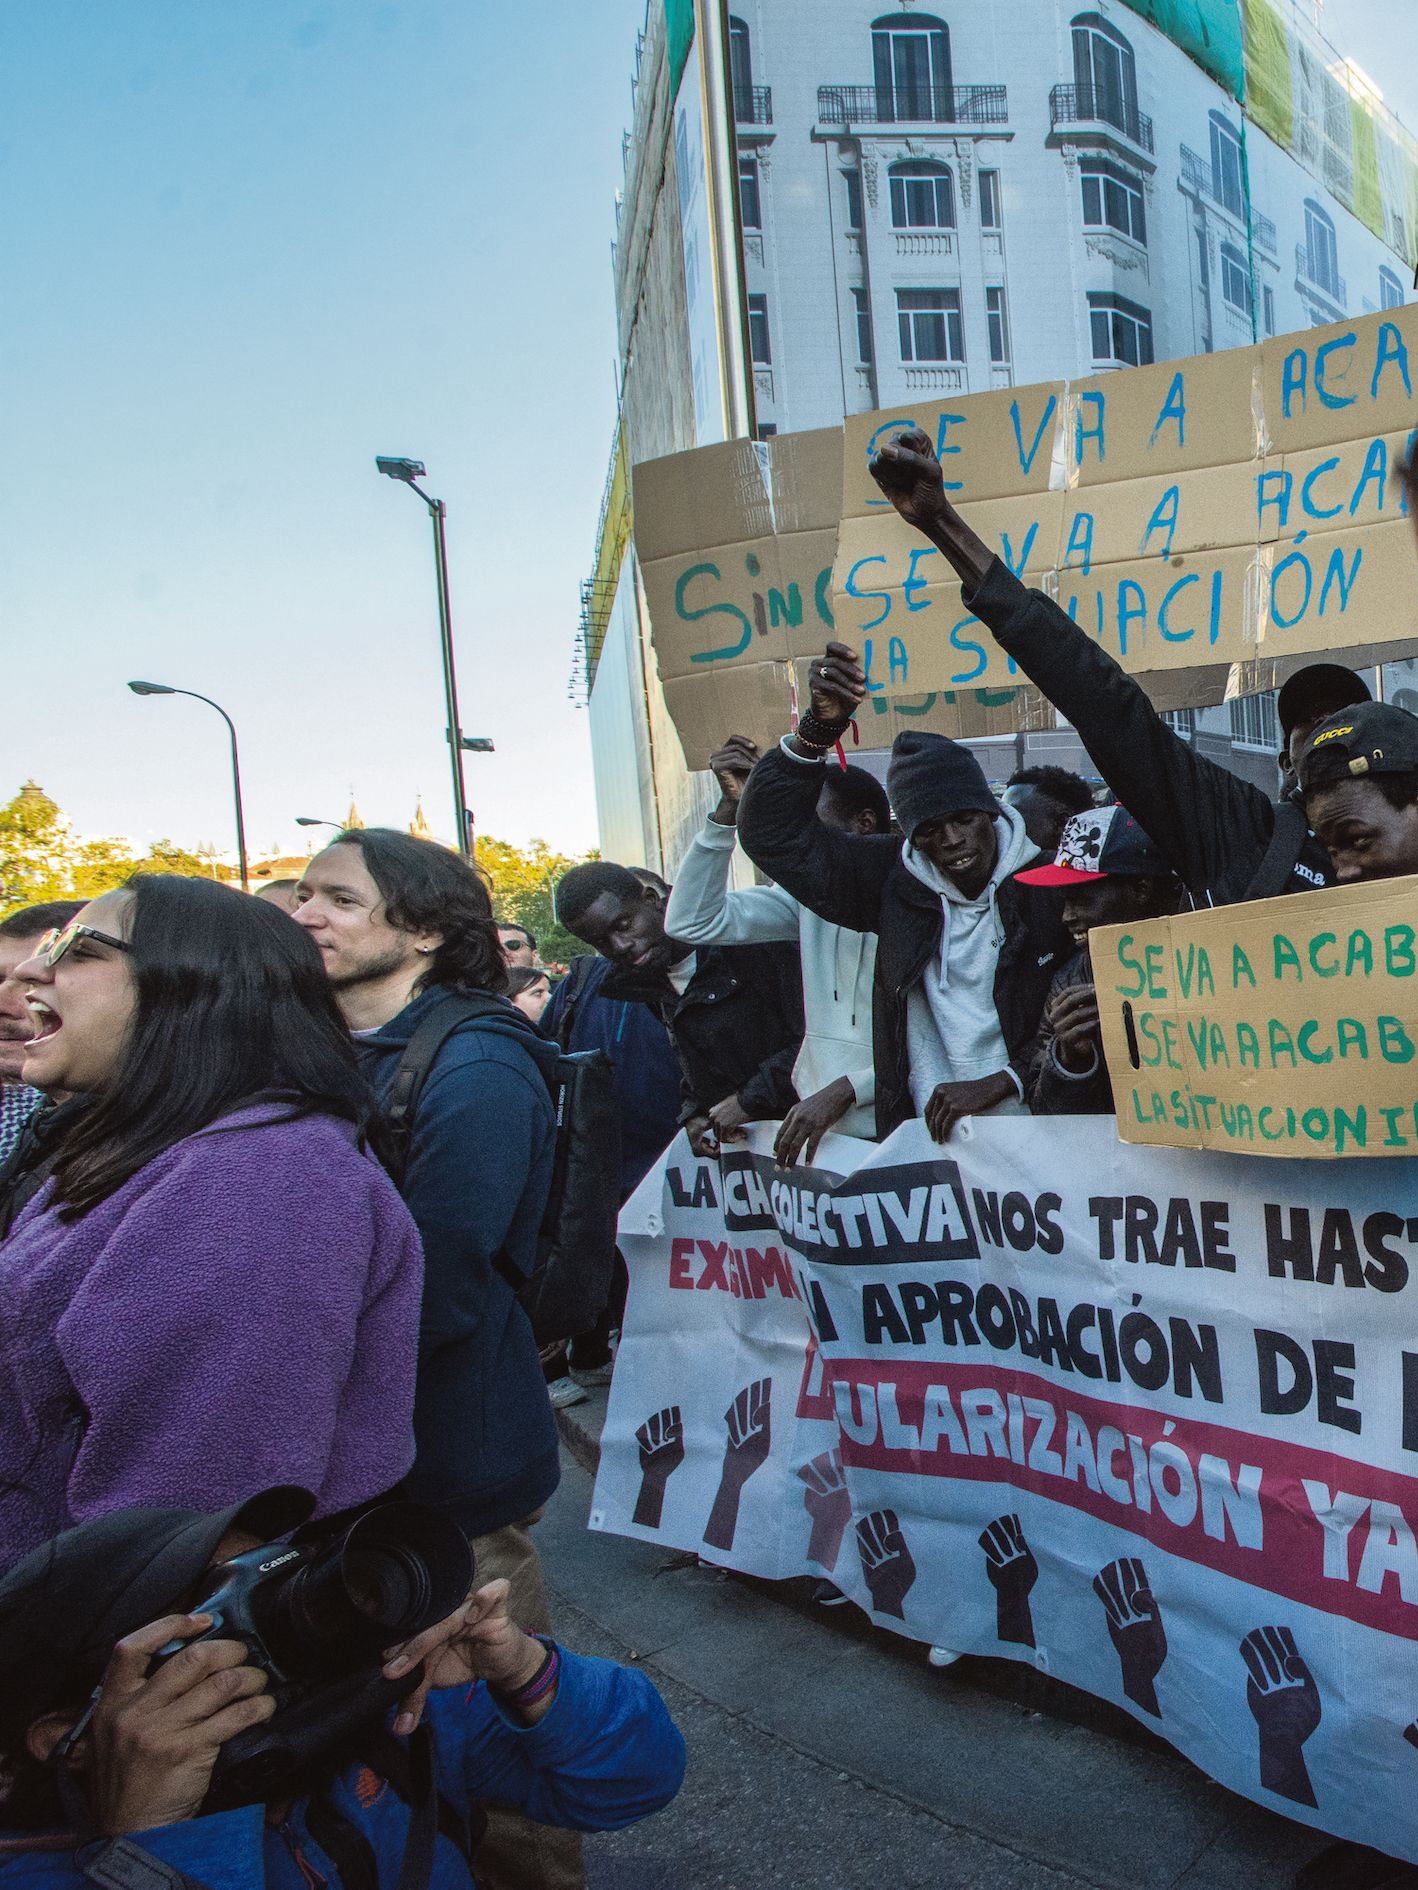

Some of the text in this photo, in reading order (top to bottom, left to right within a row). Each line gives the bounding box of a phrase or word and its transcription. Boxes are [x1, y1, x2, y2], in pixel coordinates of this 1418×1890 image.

[1148, 372, 1186, 448] A
[846, 548, 938, 630] SE
[1138, 485, 1178, 562] A
[863, 637, 909, 692] LA
[666, 1166, 718, 1209] LA
[770, 1179, 968, 1249] COLECTIVA
[971, 1187, 1065, 1255] NOS
[1088, 1195, 1237, 1273] TRAE
[861, 1280, 1224, 1404] APROBACIÓN
[1253, 1328, 1362, 1435] DE
[829, 1380, 1264, 1551] ULARIZACIÓN
[259, 1549, 300, 1572] Canon
